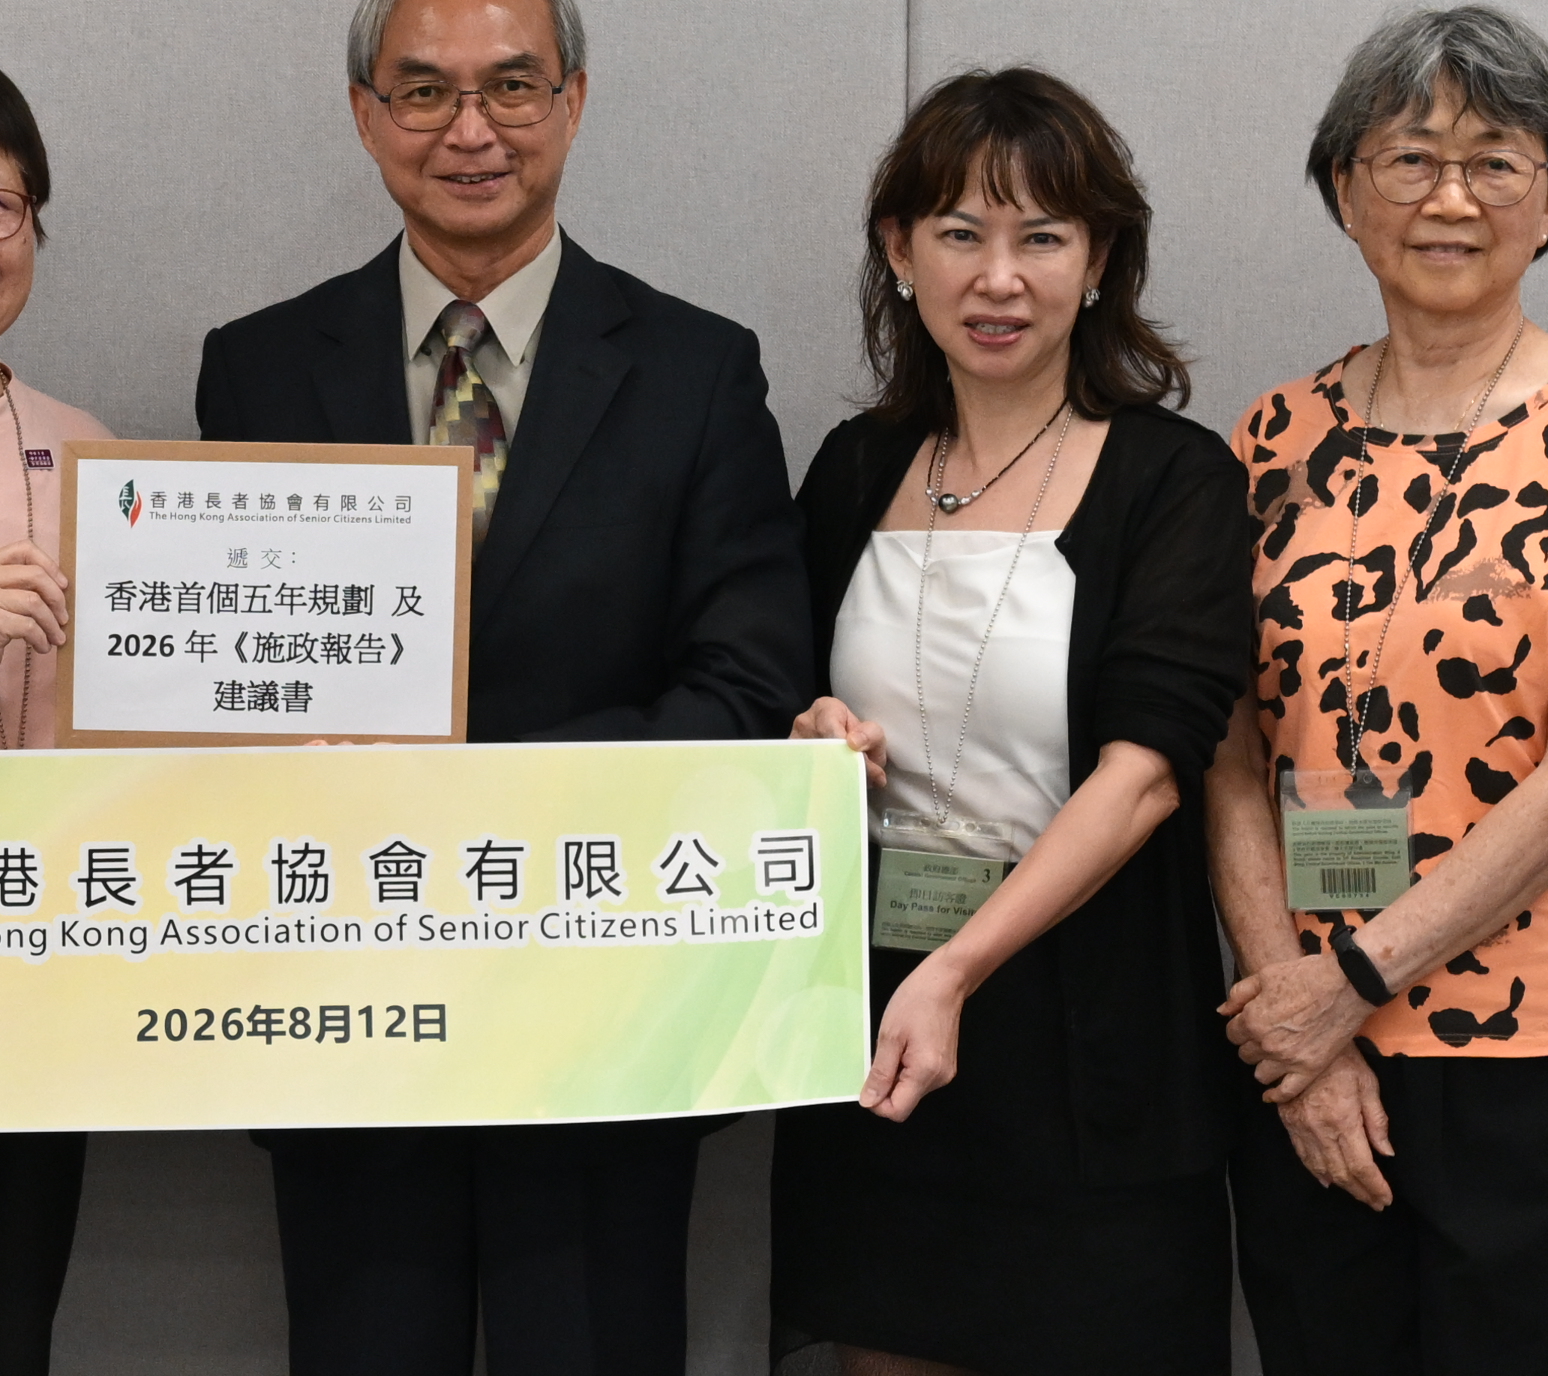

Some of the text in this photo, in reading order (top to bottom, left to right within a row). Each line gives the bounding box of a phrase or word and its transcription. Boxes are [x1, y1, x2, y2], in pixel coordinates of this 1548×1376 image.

[150, 491, 412, 512] 香港長者協會有限公司
[149, 511, 412, 525] The Hong Kong Association of Senior Citizens Limited
[105, 580, 424, 616] 香港首個五年規劃 及
[107, 633, 175, 658] 2026
[213, 680, 313, 713] 建議書
[982, 868, 991, 883] 3
[890, 900, 908, 911] Day
[911, 902, 933, 912] Pass
[937, 905, 950, 914] for
[61, 920, 148, 955] Kong
[160, 915, 361, 946] Association
[374, 913, 408, 942] of
[418, 912, 529, 942] Senior
[539, 911, 678, 940] Citizens
[690, 902, 818, 936] Limited
[137, 1004, 446, 1045] 2026年8月12日
